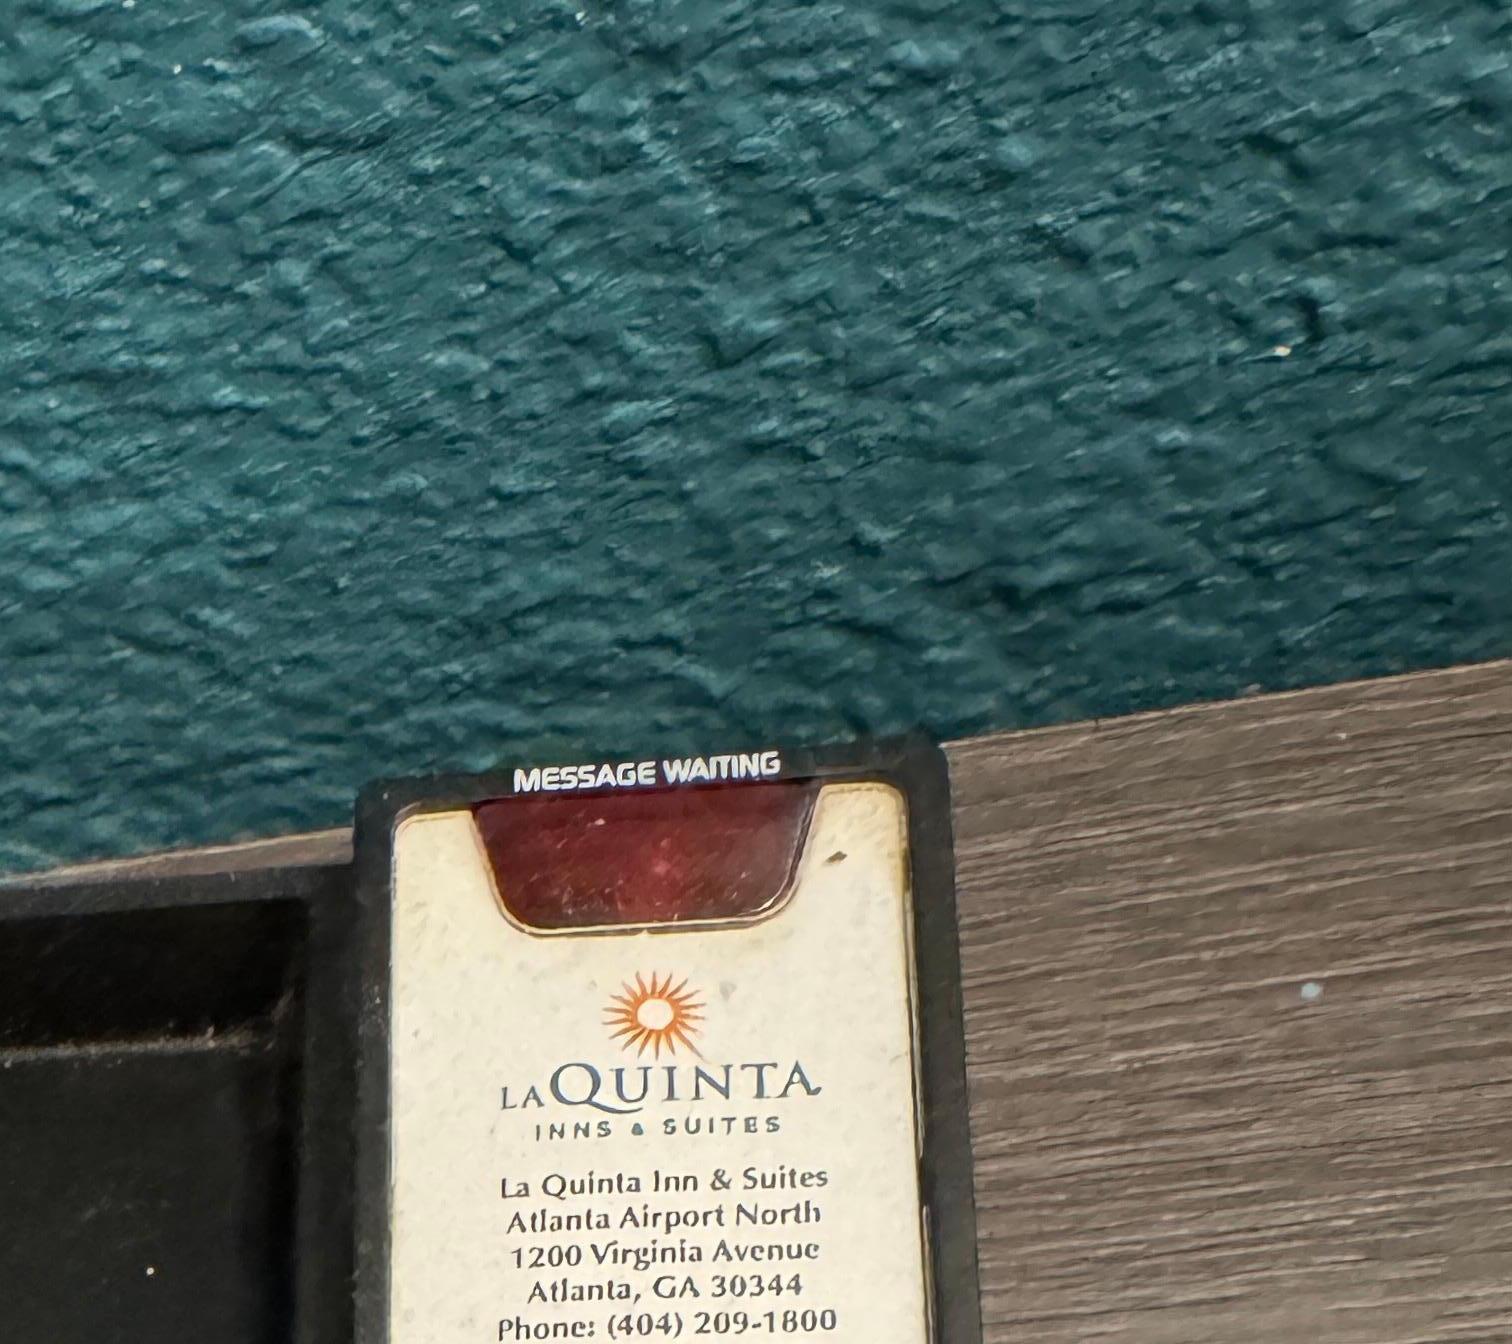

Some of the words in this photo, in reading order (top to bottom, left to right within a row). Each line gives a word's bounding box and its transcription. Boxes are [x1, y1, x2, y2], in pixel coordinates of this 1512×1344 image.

[513, 761, 656, 793] MESSAGE
[663, 750, 781, 785] WAITING
[535, 1120, 612, 1141] INNS
[664, 1116, 781, 1137] SUITES
[501, 1177, 530, 1199] La
[542, 1171, 641, 1199] Quinta
[653, 1170, 698, 1192] Inn
[710, 1168, 731, 1190] &
[743, 1165, 828, 1190] Suites
[507, 1207, 610, 1234] Atlanta
[619, 1203, 726, 1234] Airport
[736, 1200, 821, 1225] North
[511, 1245, 582, 1269] 1200
[591, 1239, 702, 1270] Virginia
[712, 1239, 819, 1263] Avenue
[527, 1280, 642, 1304] Atlanta,
[653, 1276, 700, 1298] GA
[711, 1273, 802, 1297] 30344
[498, 1317, 594, 1341] Phone:
[607, 1313, 683, 1339] (404)
[694, 1309, 837, 1334] 209-1800
